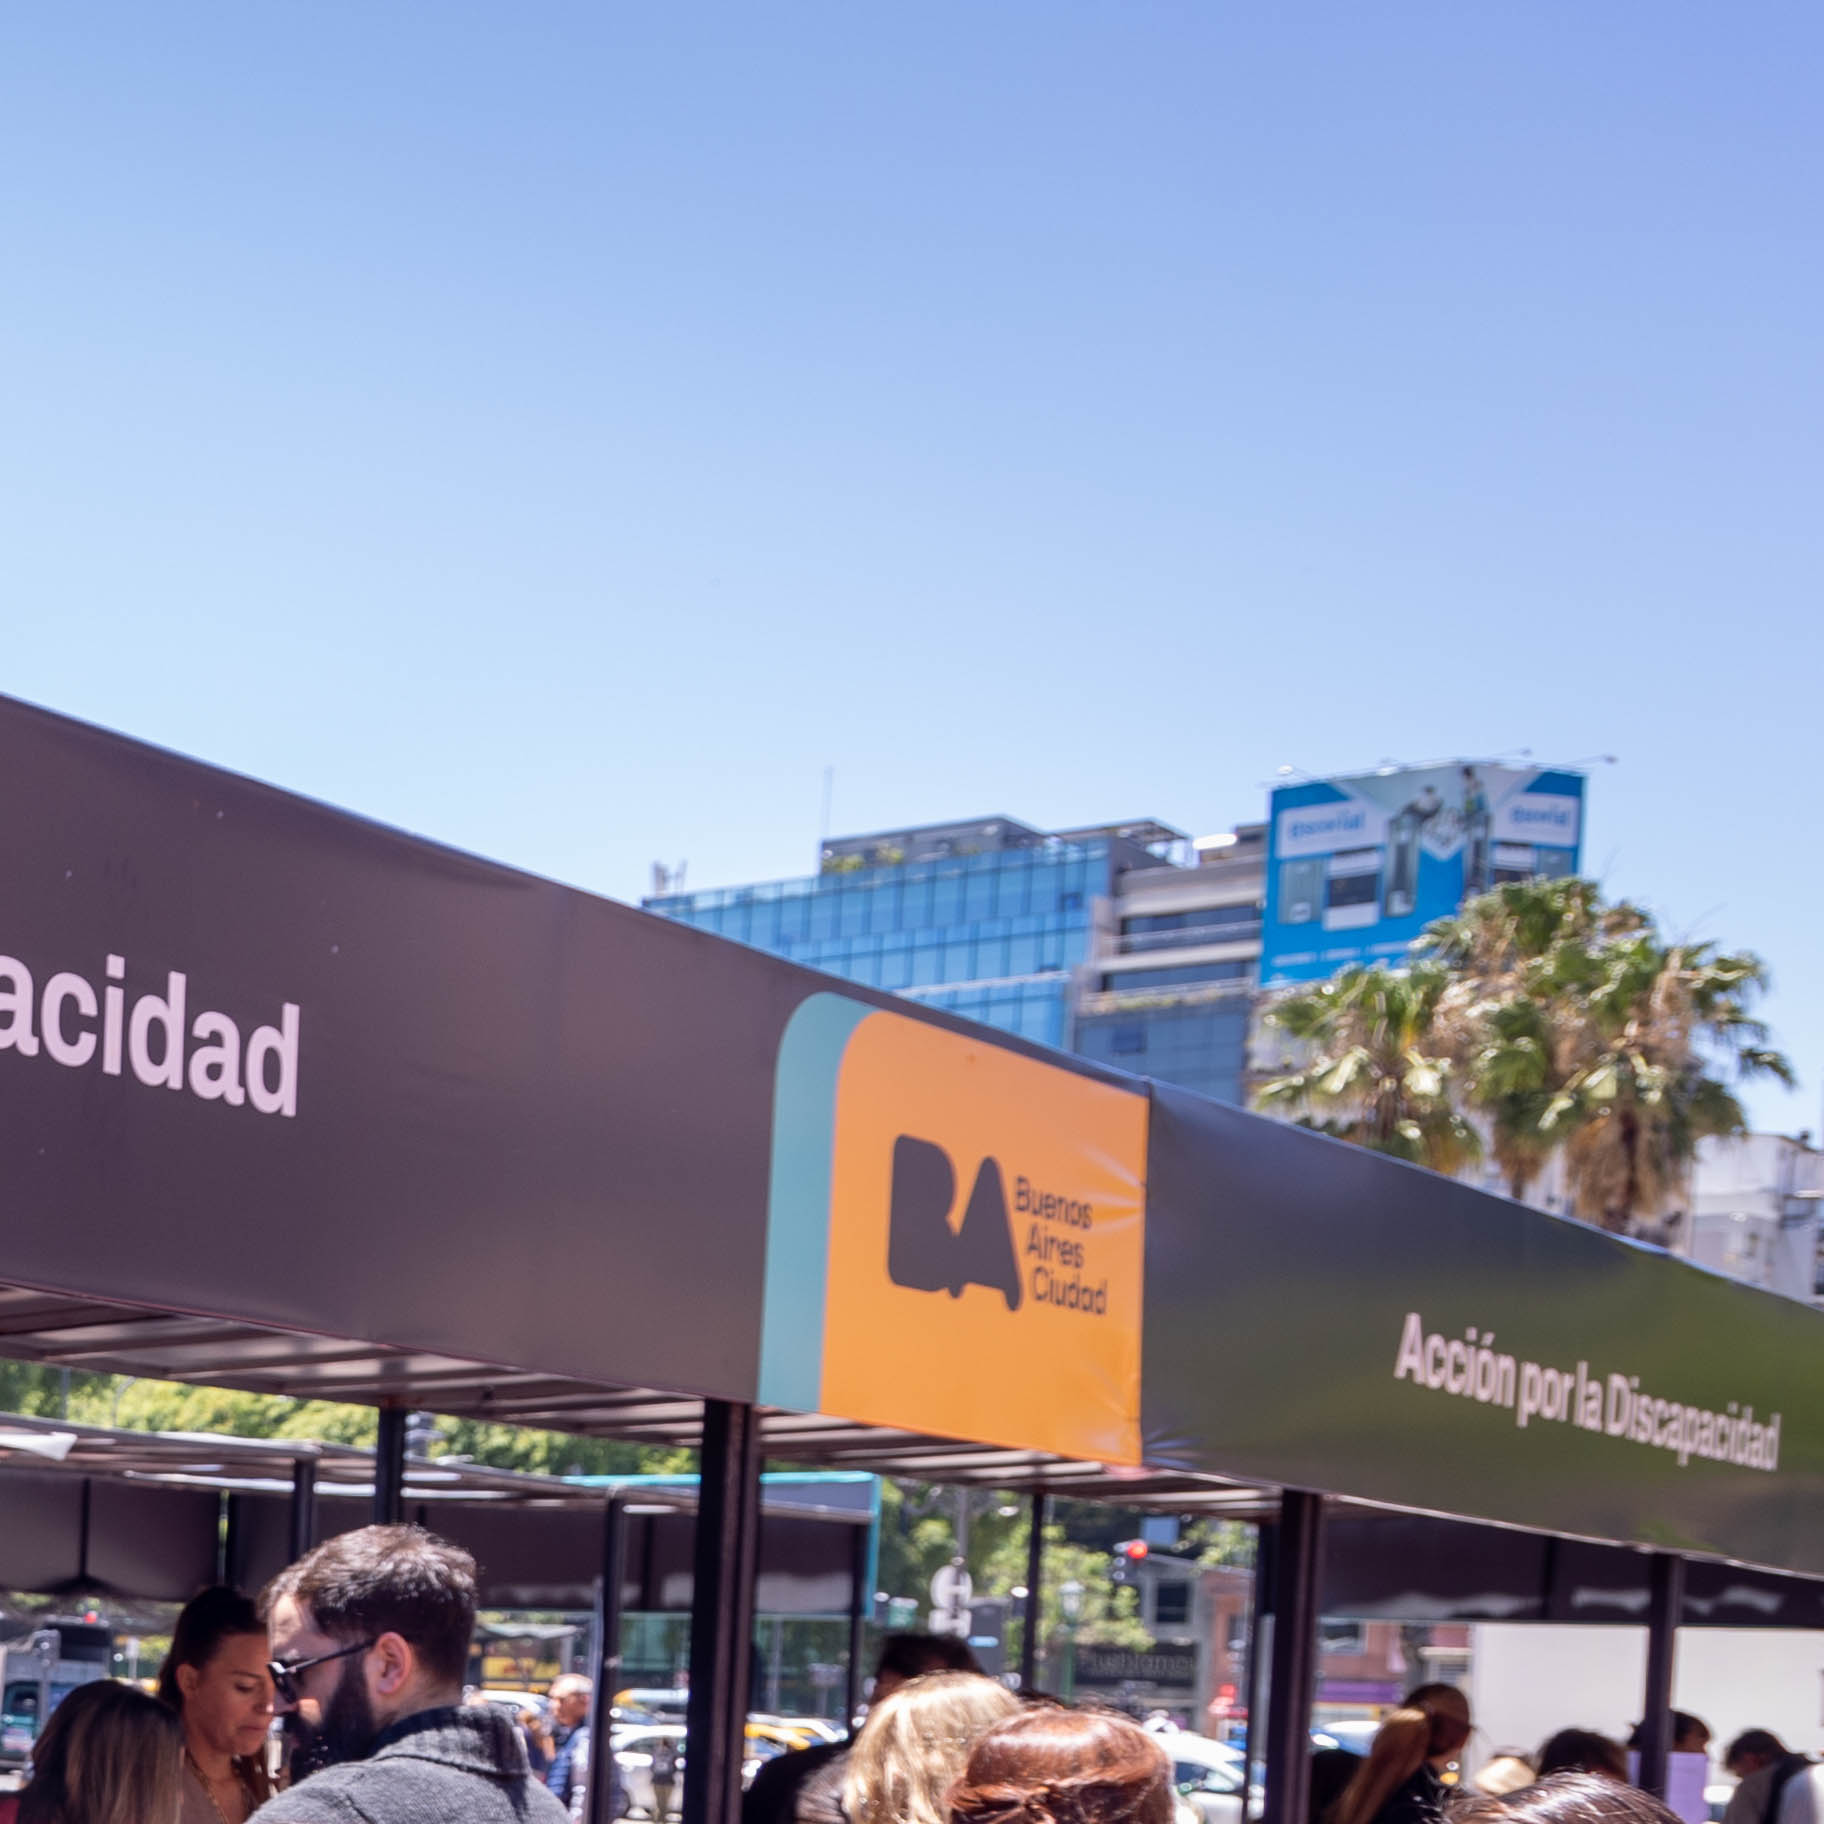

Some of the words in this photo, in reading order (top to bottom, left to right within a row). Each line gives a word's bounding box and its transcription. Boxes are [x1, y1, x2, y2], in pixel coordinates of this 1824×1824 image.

[1014, 1174, 1094, 1231] Buenos
[1026, 1222, 1085, 1270] Aires
[1032, 1265, 1109, 1316] Ciudad
[1393, 1311, 1517, 1409] Acción
[1515, 1360, 1576, 1429] por
[1573, 1360, 1603, 1433] la
[1603, 1372, 1782, 1472] Discapacidad
